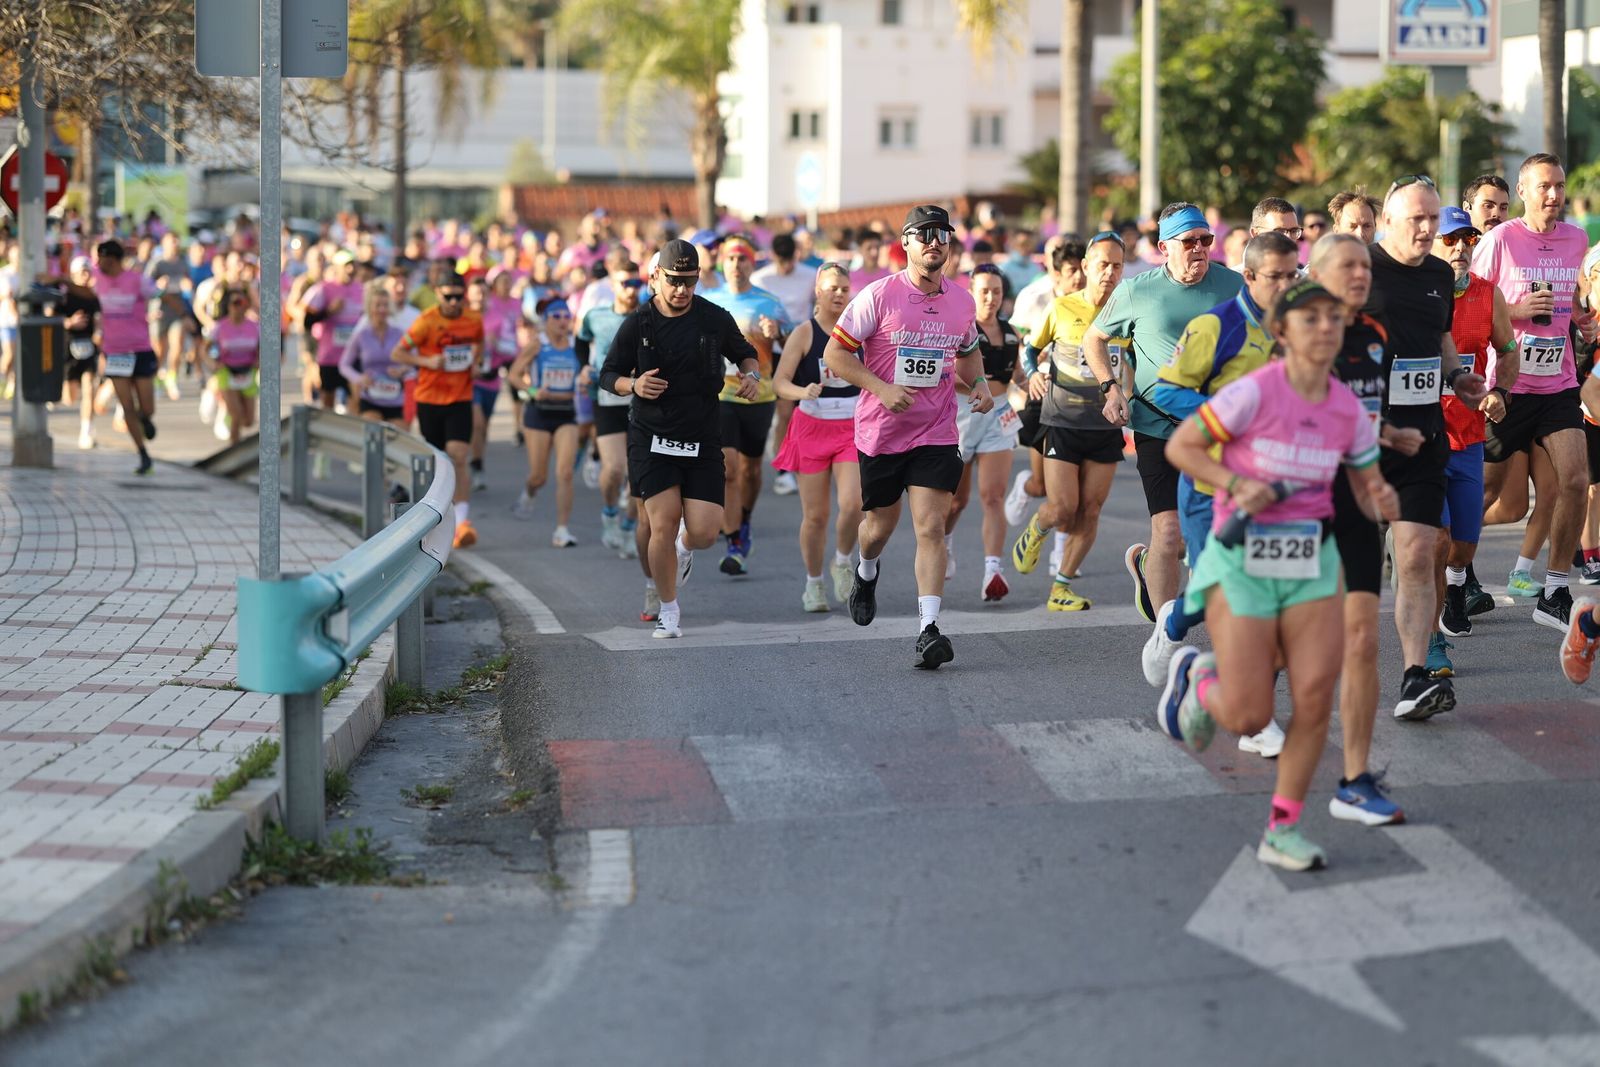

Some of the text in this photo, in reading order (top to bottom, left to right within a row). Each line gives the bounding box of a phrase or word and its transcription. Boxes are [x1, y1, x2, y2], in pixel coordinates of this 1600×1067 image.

[1403, 24, 1480, 47] ALDI
[1538, 257, 1563, 267] XXXVI
[1509, 265, 1578, 282] MEDIA MARATÓ
[1514, 282, 1568, 293] INTEONAL
[919, 319, 945, 333] XXXVI
[920, 333, 964, 348] MARATÓ
[1081, 354, 1119, 367] 29
[1523, 346, 1563, 364] 1727
[904, 358, 936, 375] 365
[1401, 371, 1435, 390] 168
[656, 436, 697, 452] 1543
[1251, 538, 1316, 560] 2528
